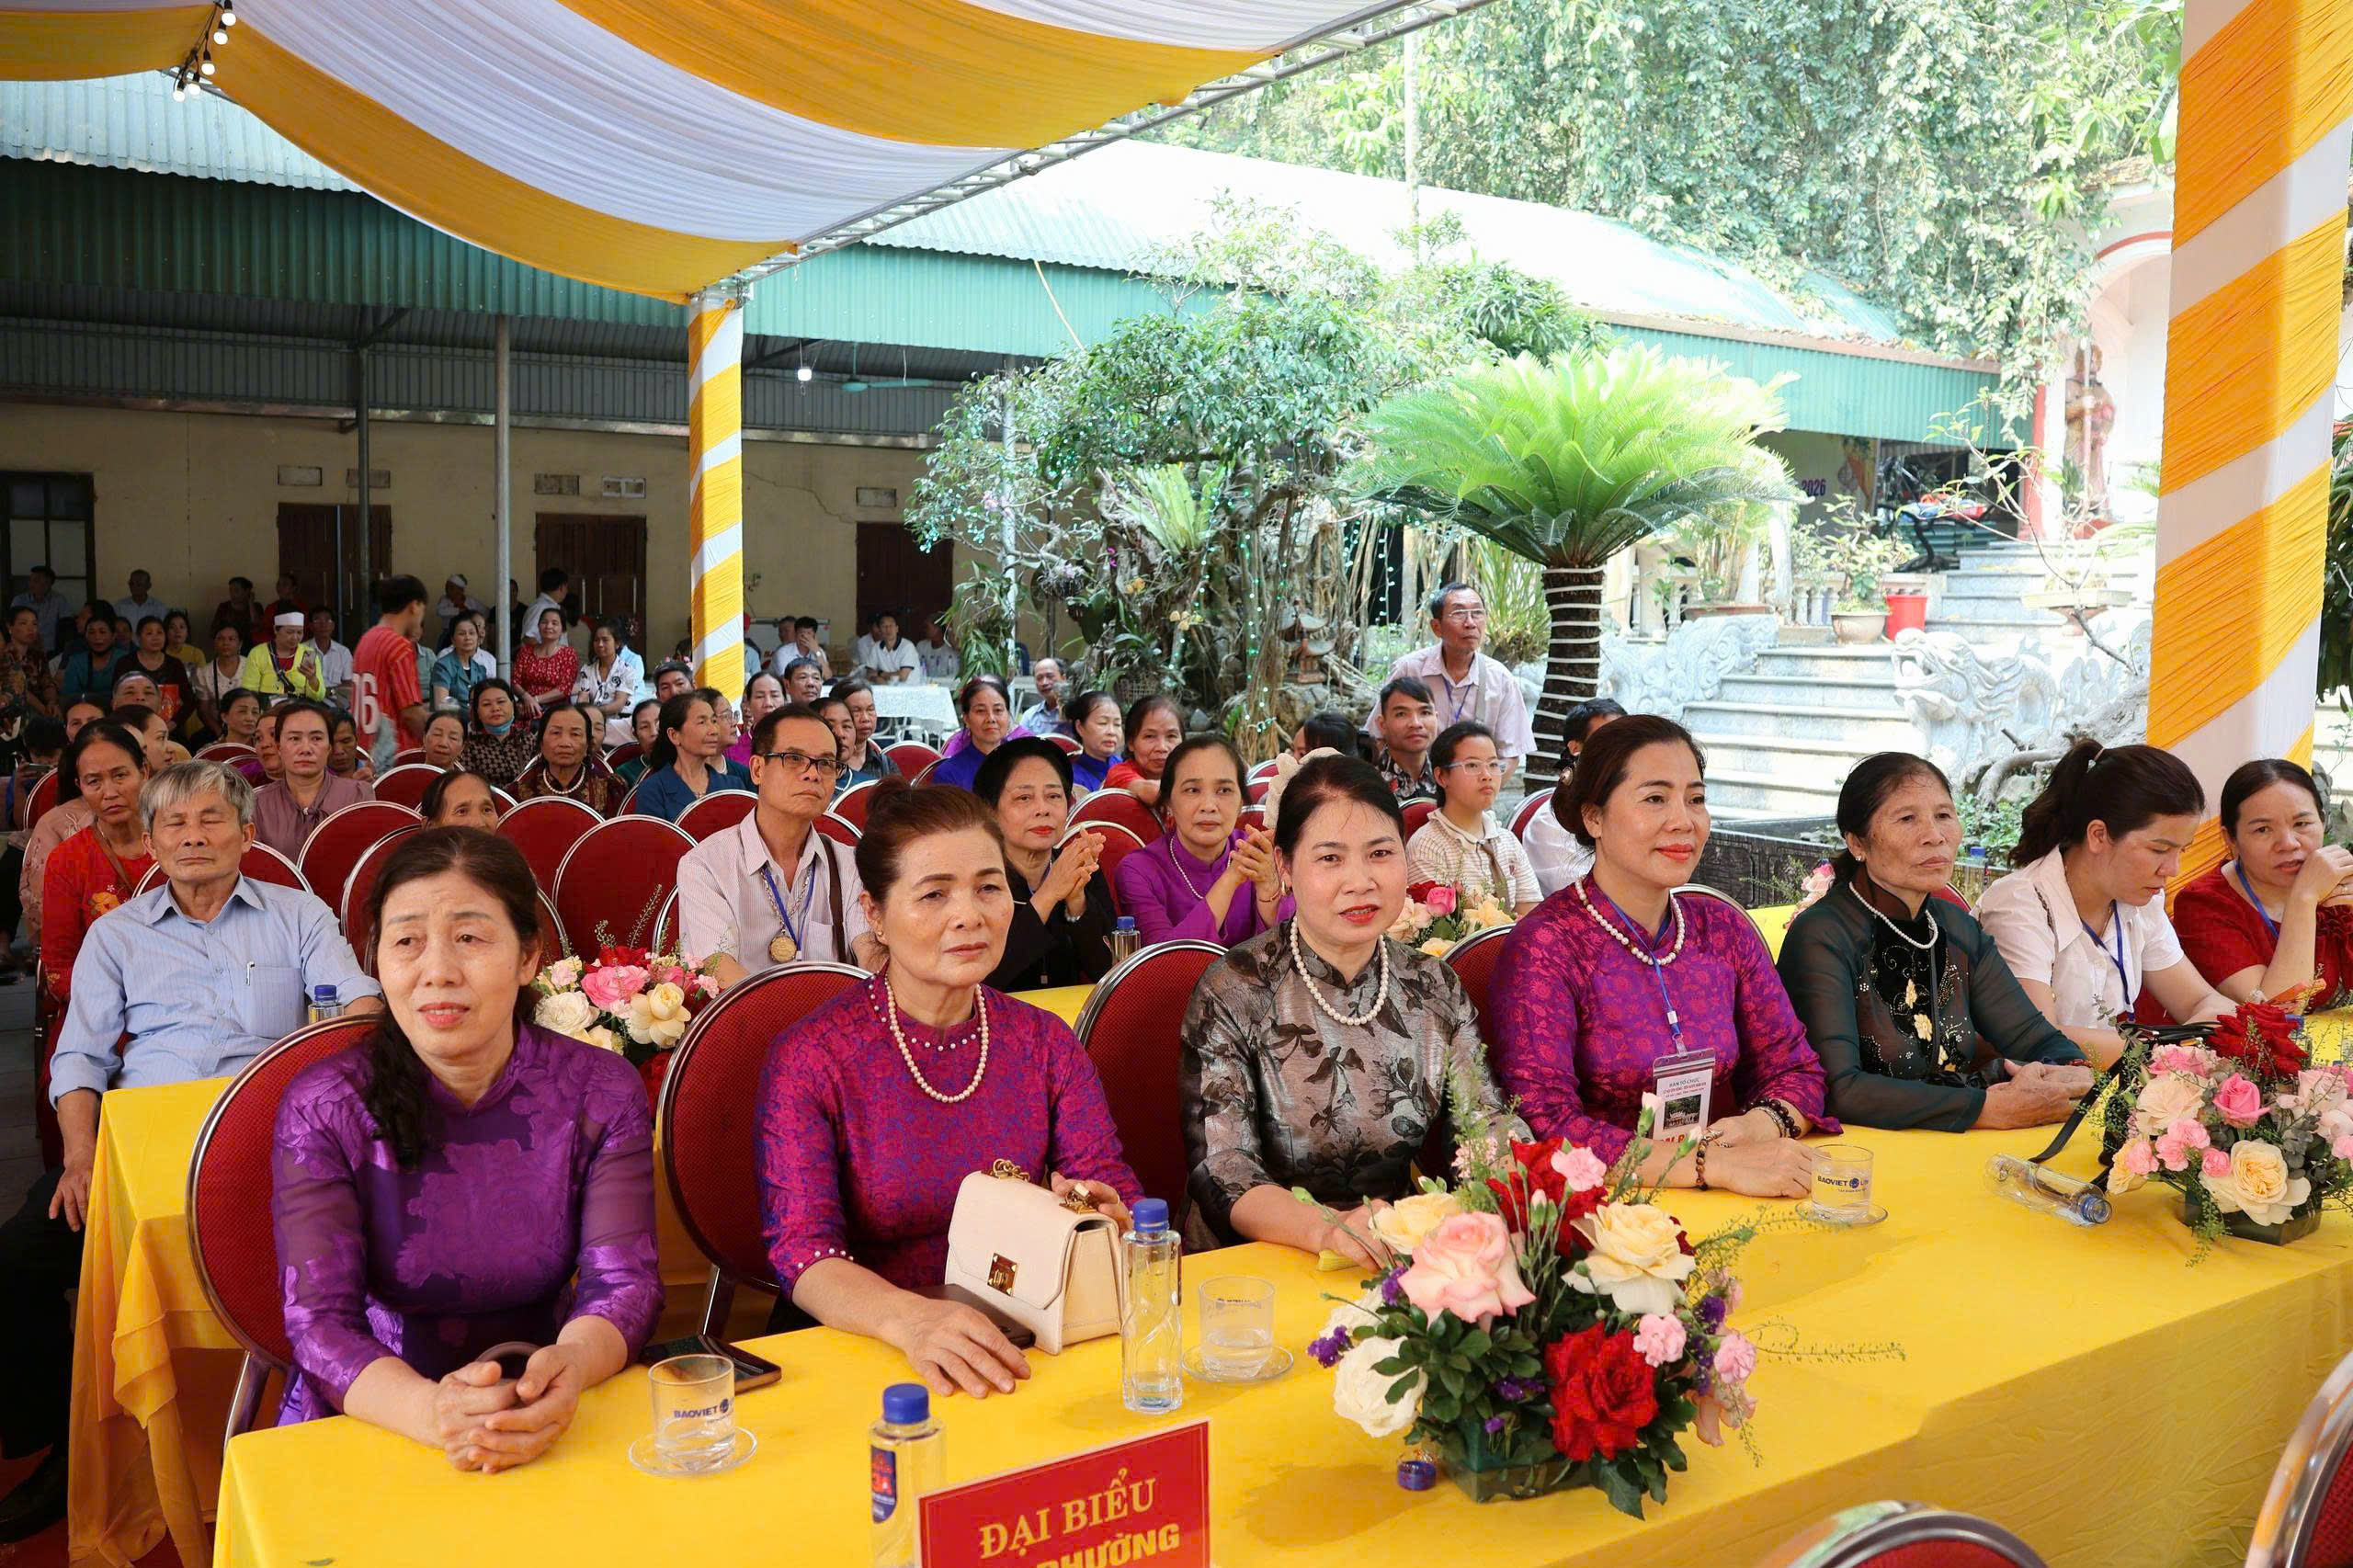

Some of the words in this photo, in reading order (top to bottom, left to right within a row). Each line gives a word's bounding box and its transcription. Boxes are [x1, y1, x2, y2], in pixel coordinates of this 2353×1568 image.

[1817, 1176, 1848, 1187] BAOVIET
[674, 1405, 718, 1418] BAOVIET
[978, 1507, 1052, 1560] ĐẠI
[1062, 1467, 1156, 1535] BIỂU
